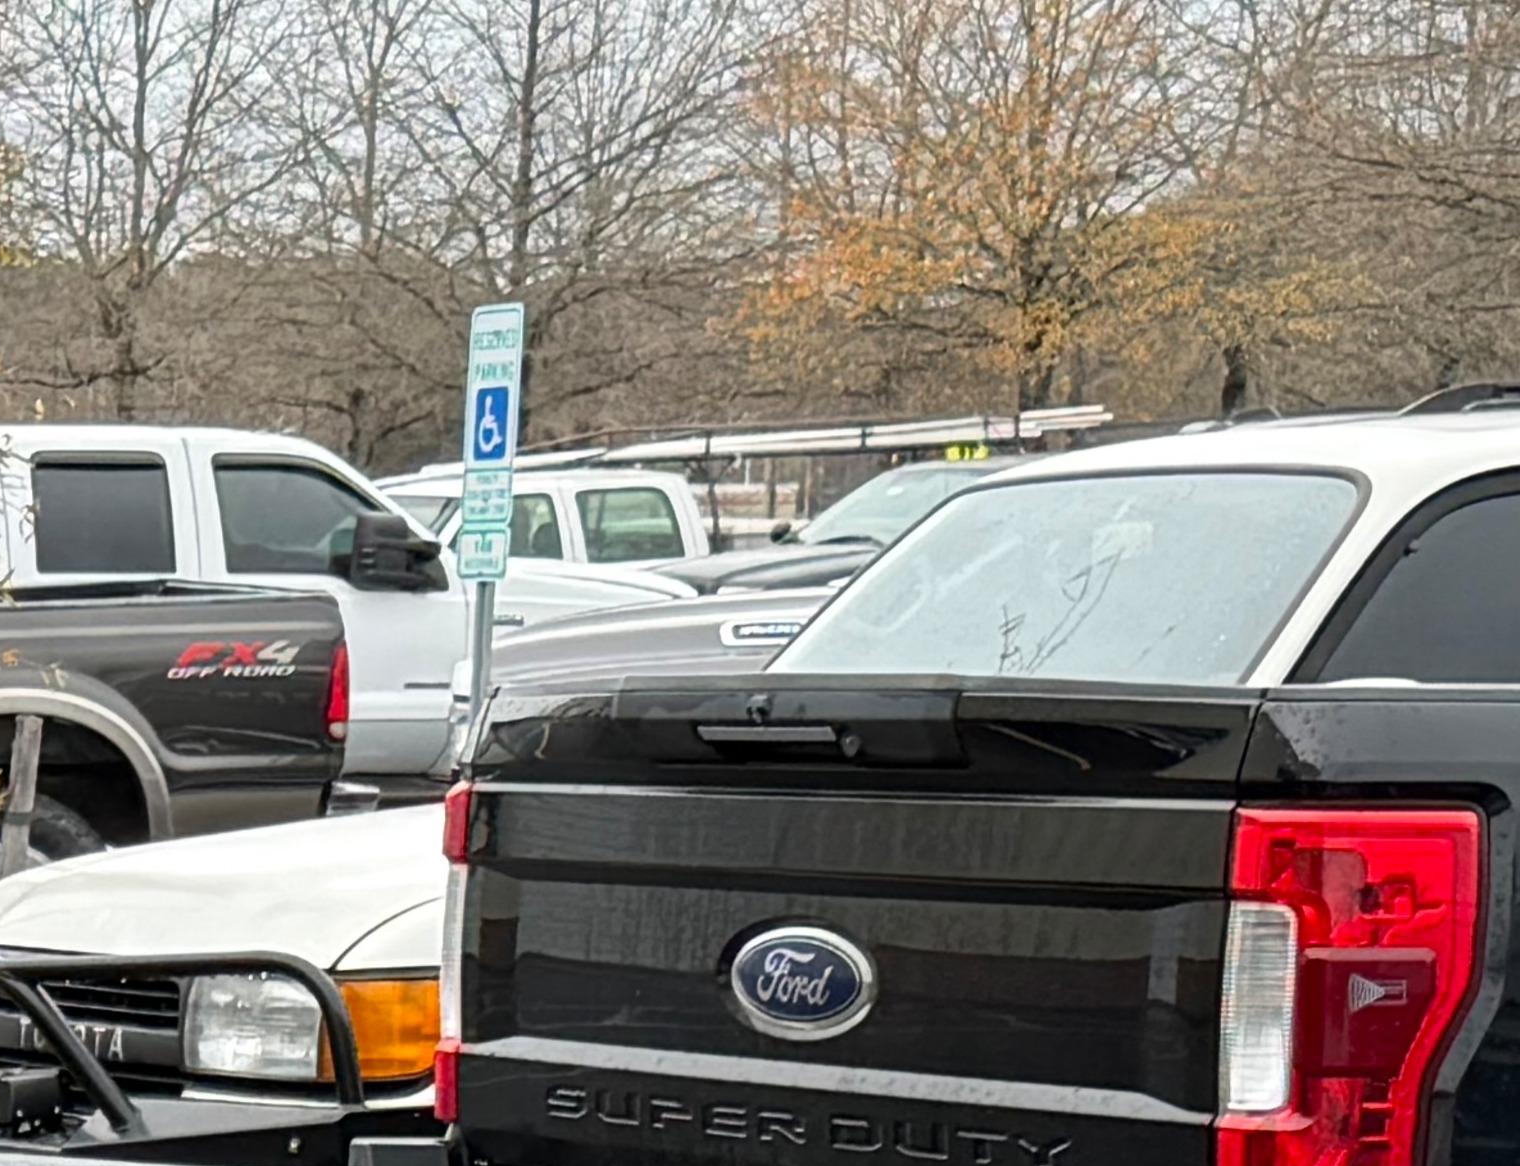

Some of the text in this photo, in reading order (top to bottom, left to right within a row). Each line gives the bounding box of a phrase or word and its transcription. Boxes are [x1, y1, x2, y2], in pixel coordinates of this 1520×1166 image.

[167, 665, 297, 679] OFF ROAD
[176, 639, 300, 667] FX4
[759, 948, 834, 1007] Ford
[546, 1088, 806, 1144] SUPER
